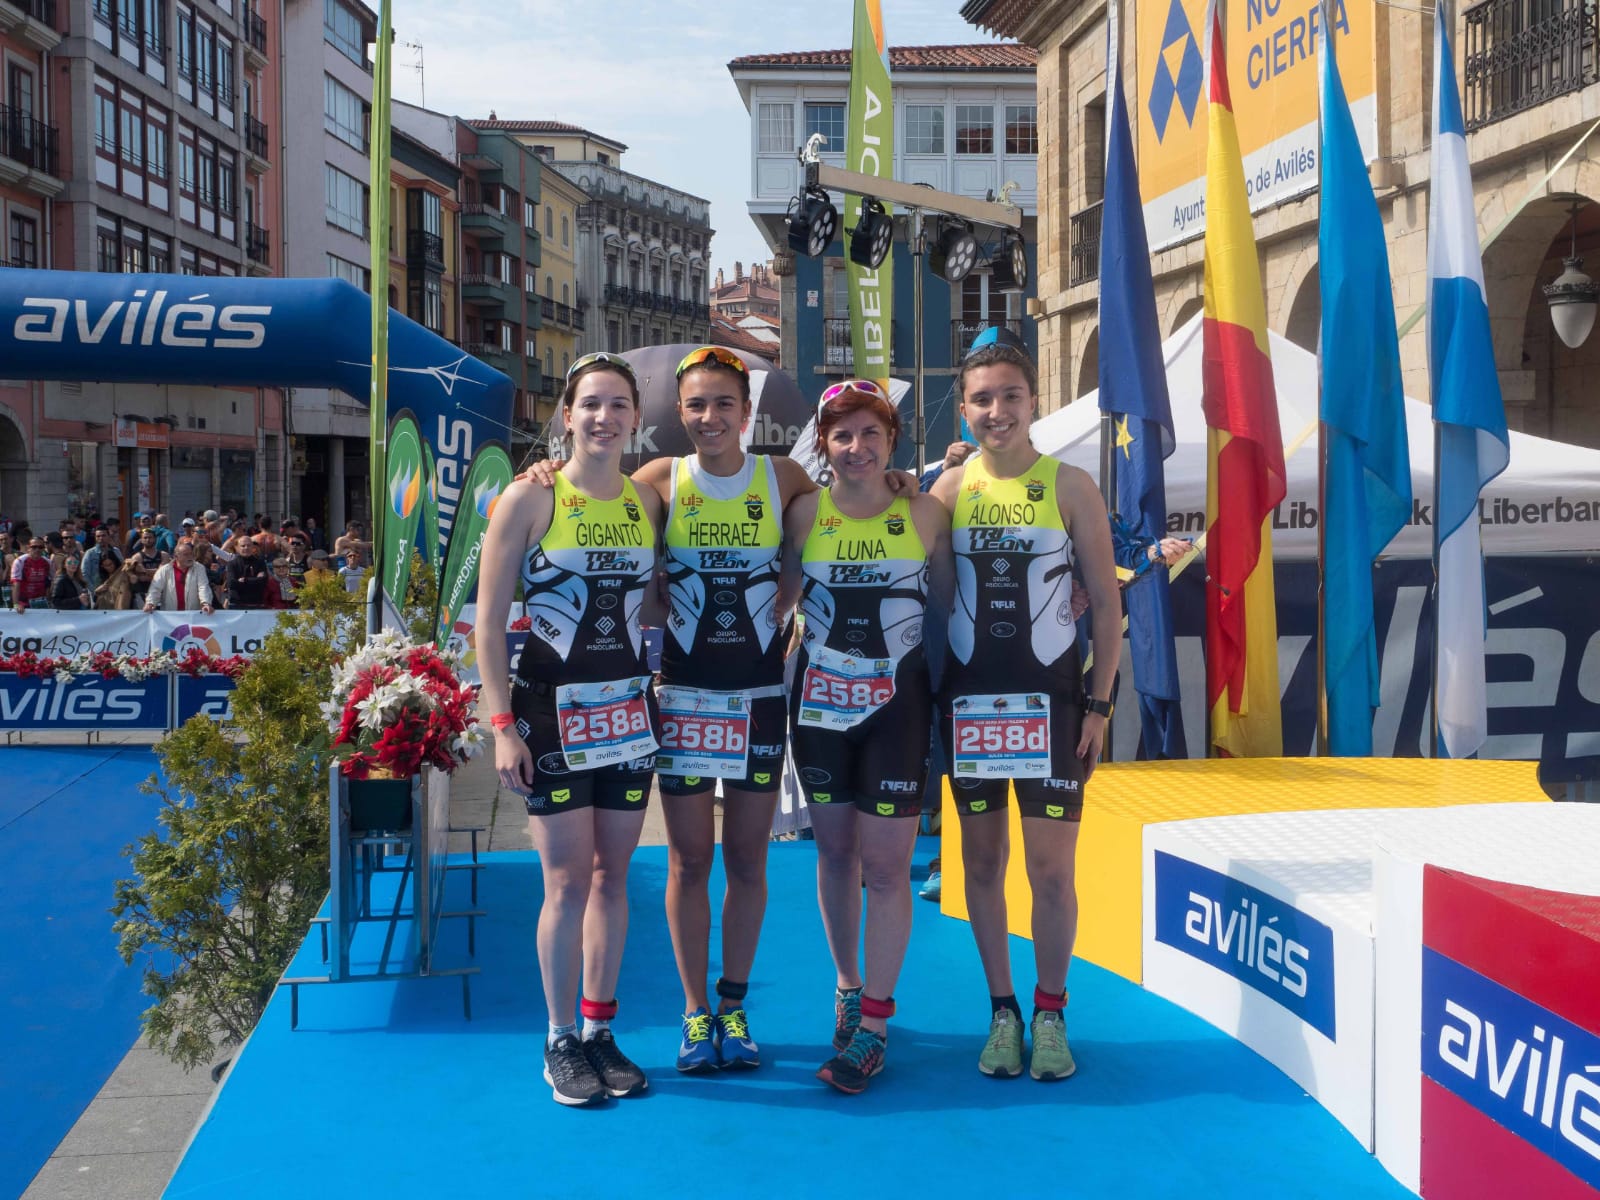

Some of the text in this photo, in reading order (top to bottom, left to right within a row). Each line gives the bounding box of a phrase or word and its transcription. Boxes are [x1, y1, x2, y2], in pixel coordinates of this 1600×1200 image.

[1255, 167, 1271, 193] de
[1274, 147, 1315, 185] Avilés
[13, 290, 273, 349] avilés
[967, 503, 1036, 526] ALONSO
[576, 522, 643, 547] GIGANTO
[688, 522, 761, 547] HERRAEZ
[967, 527, 1006, 541] TRI
[584, 551, 617, 563] TRI
[698, 550, 730, 561] TRI
[836, 538, 887, 561] LUNA
[828, 564, 865, 574] TRI
[809, 676, 891, 706] 258c
[565, 708, 646, 743] 258a
[660, 721, 744, 751] 258b
[960, 724, 1045, 752] 258d
[1185, 890, 1310, 998] avilés
